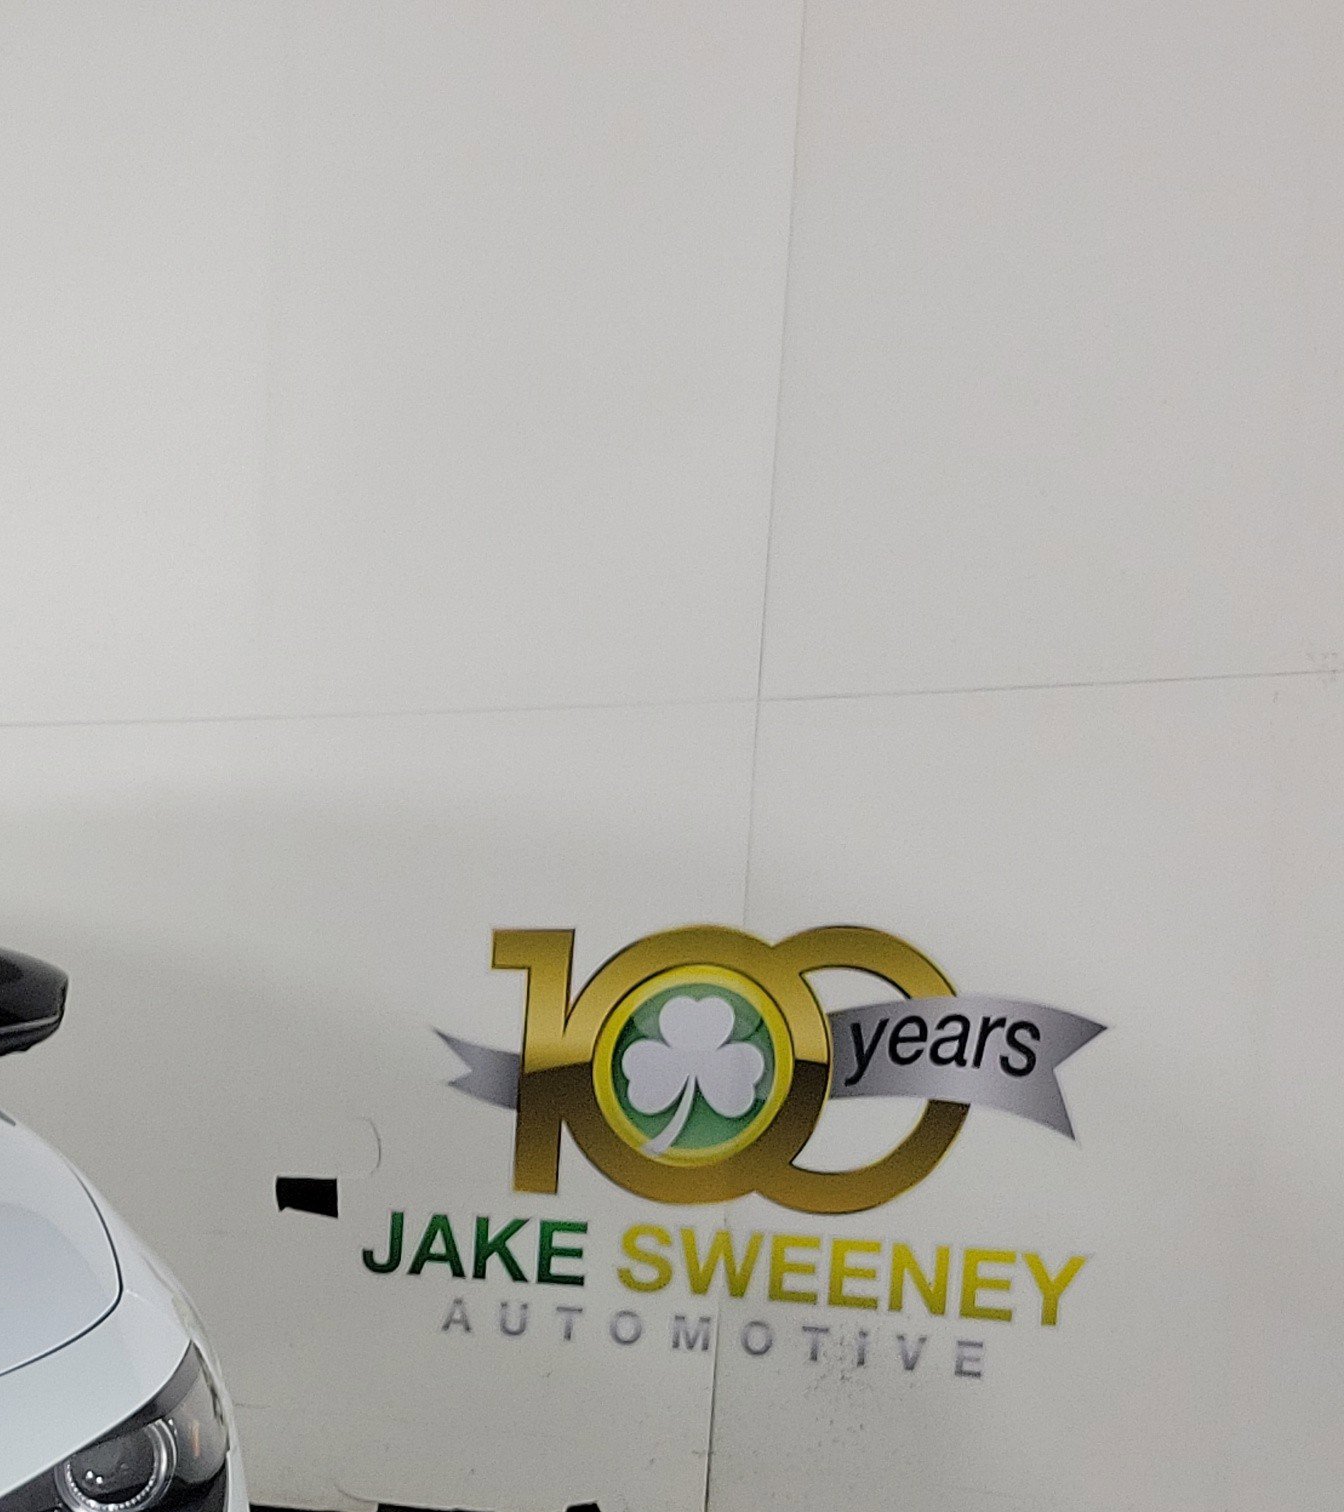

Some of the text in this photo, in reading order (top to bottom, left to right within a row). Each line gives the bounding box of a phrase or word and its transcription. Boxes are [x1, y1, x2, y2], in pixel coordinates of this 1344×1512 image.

[492, 925, 1040, 1214] 100 years
[362, 1212, 1086, 1326] JAKE SWEENEY
[443, 1298, 985, 1378] AUTOMOTIVE
